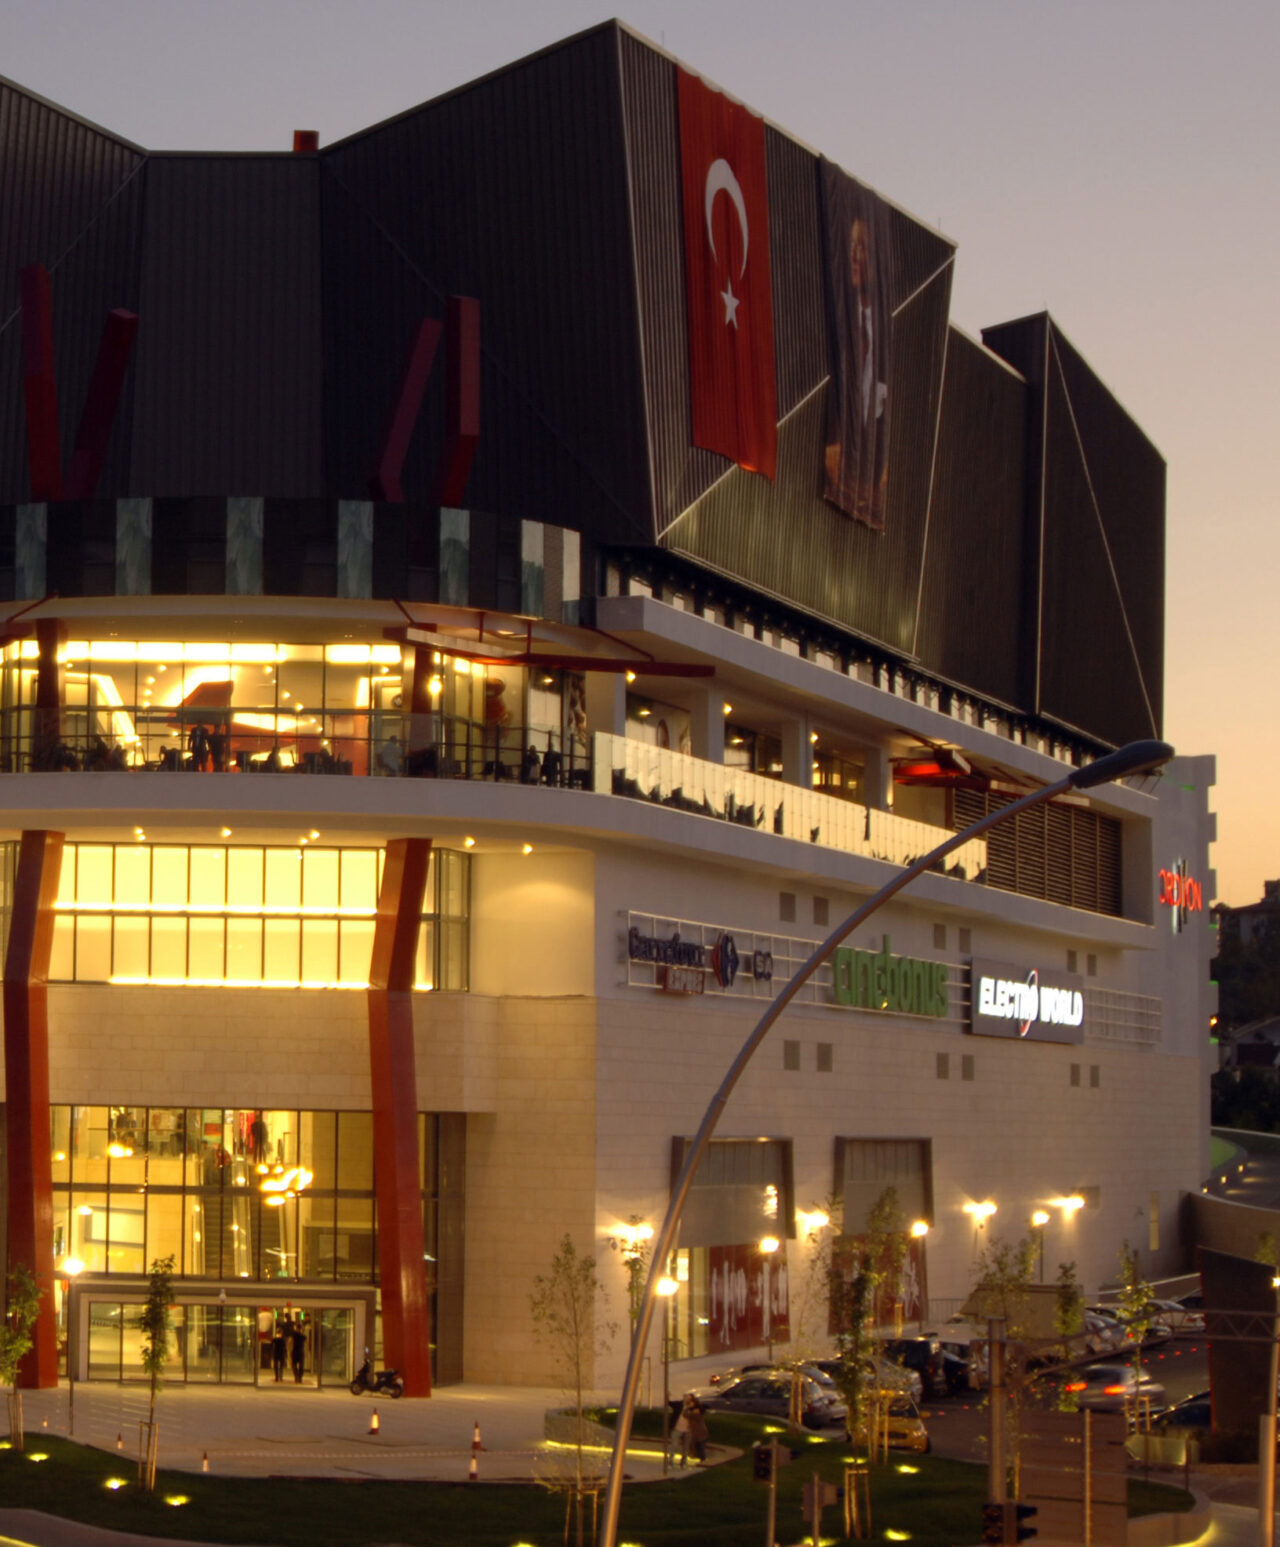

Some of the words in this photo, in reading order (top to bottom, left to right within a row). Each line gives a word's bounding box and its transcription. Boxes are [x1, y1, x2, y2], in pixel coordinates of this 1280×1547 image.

[835, 934, 949, 1018] cinebonus
[978, 976, 1039, 1022] ELECTRO
[1040, 985, 1084, 1027] WORLD
